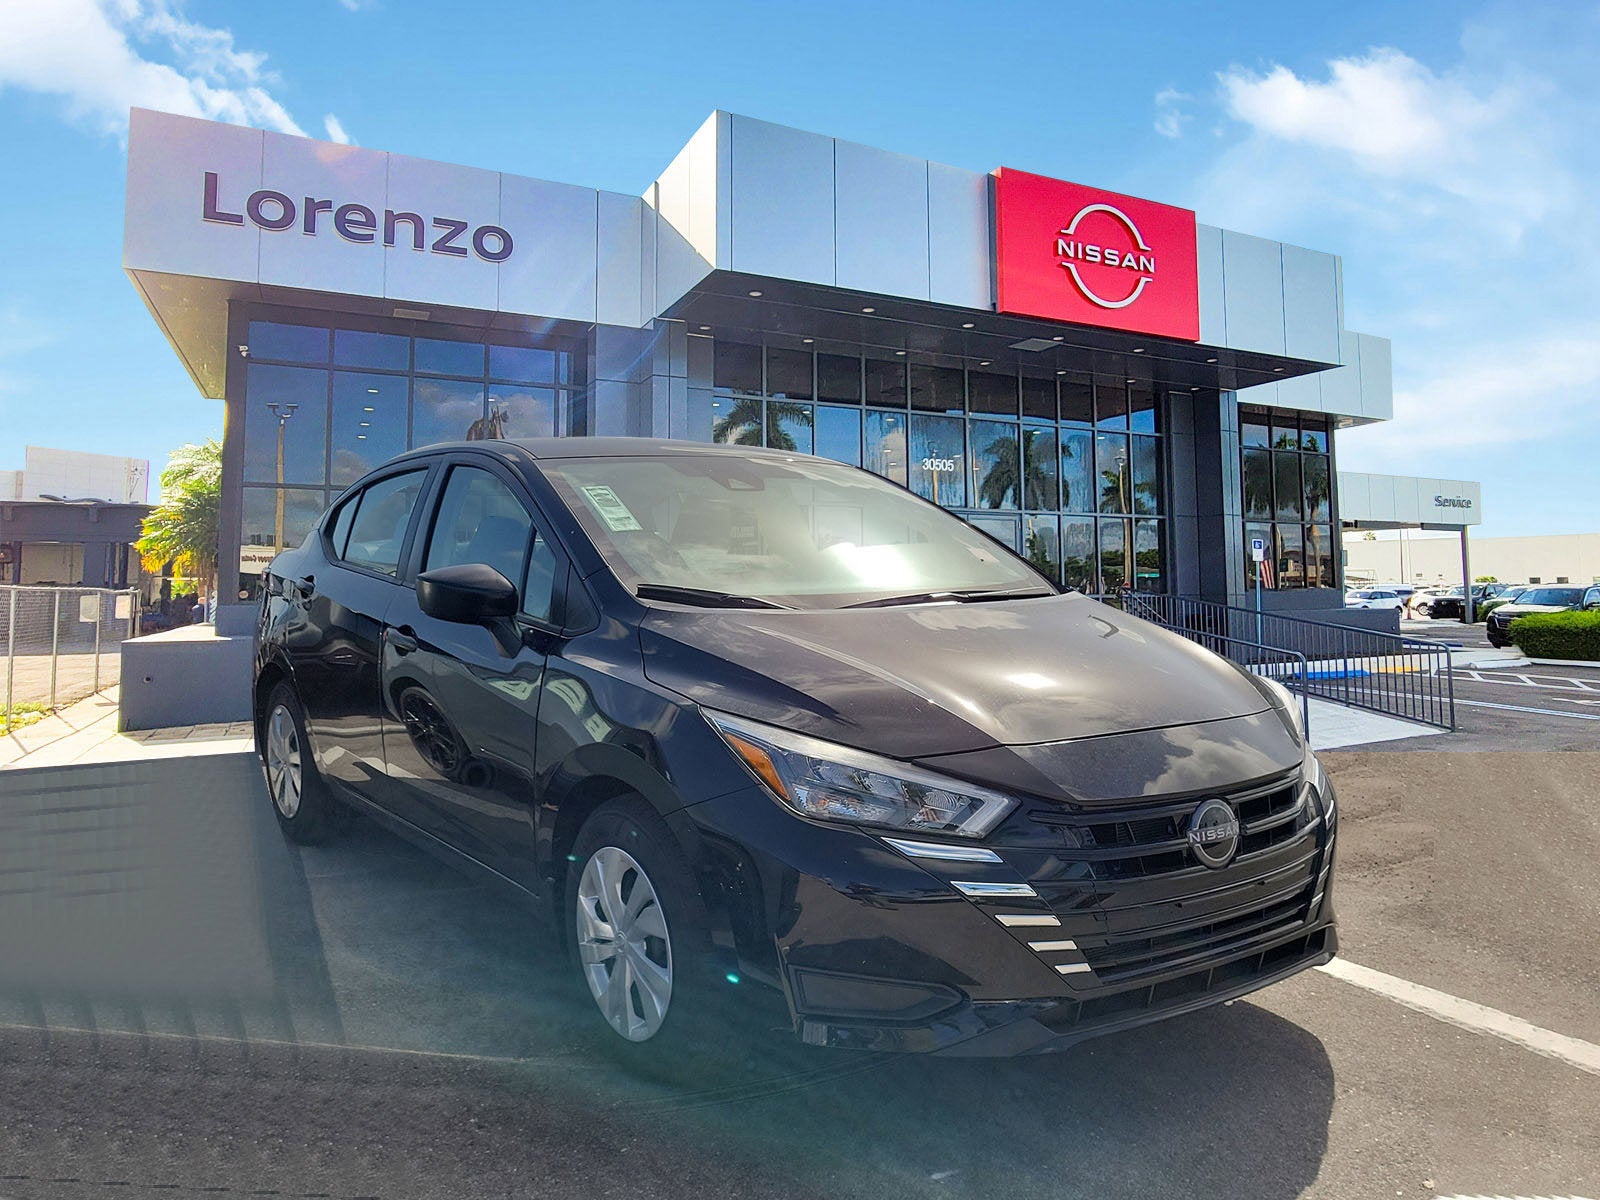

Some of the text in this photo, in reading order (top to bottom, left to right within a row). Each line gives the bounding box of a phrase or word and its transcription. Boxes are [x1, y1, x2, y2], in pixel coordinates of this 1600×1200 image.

[202, 171, 515, 263] Lorenzo
[1057, 238, 1155, 273] NISSAN
[922, 458, 955, 472] 30505
[1434, 495, 1472, 509] Service
[1189, 822, 1239, 843] NISSAN
